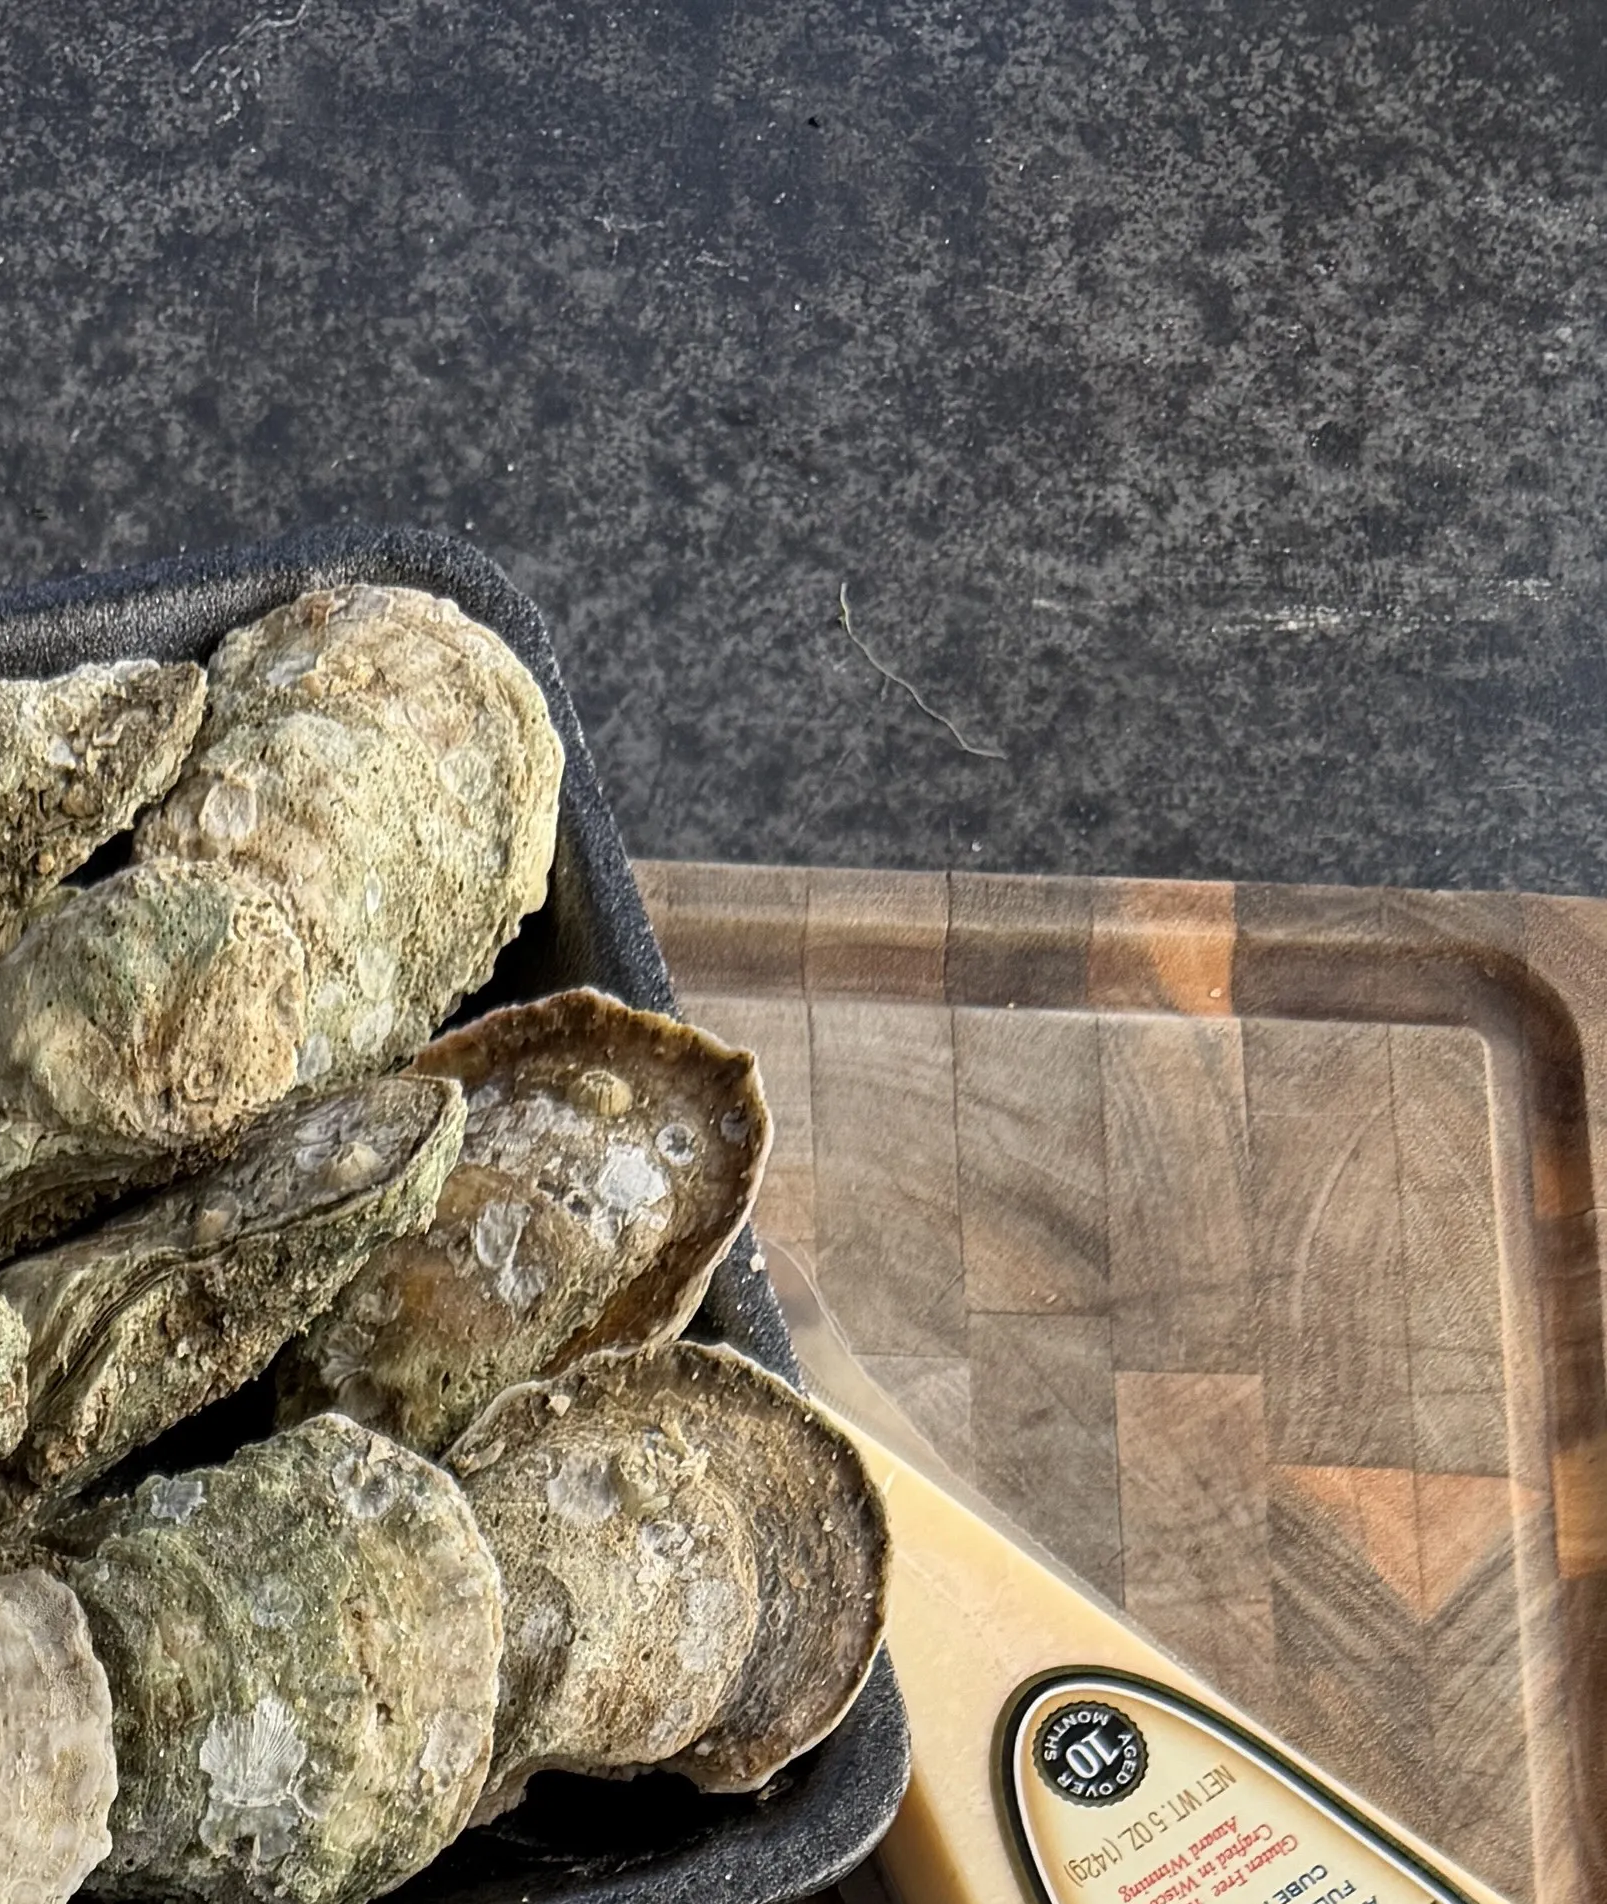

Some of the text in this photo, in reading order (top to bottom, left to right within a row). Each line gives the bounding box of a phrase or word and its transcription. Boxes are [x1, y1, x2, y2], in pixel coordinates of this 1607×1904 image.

[1044, 1709, 1110, 1761] MONTHS
[1065, 1728, 1123, 1780] 10
[1056, 1732, 1138, 1798] AGED OVER
[1200, 1764, 1237, 1802] NET
[1147, 1811, 1169, 1834] 5
[1063, 1837, 1124, 1889] (142g)
